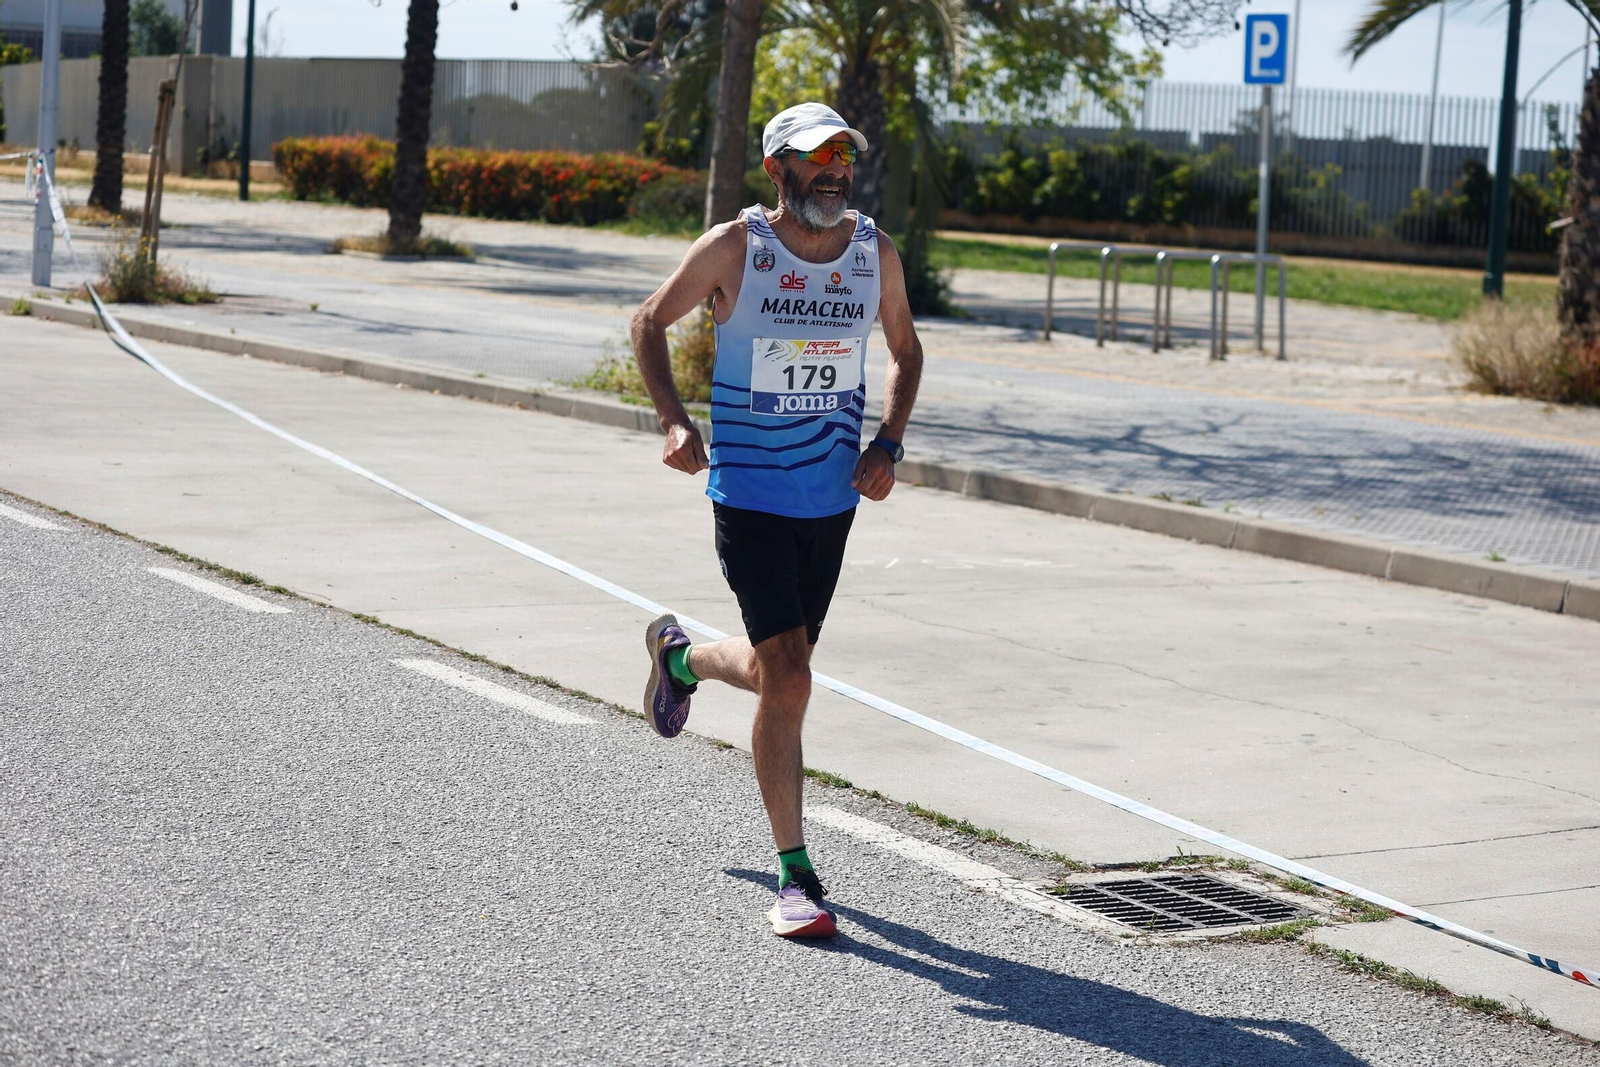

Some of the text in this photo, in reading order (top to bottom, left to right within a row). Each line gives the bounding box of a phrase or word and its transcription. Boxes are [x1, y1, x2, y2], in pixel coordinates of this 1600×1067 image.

[1251, 21, 1279, 77] P
[825, 287, 852, 296] mayfo
[761, 298, 863, 319] MARACENA
[773, 317, 796, 325] CLUB
[809, 320, 853, 329] ATLETISMO
[782, 364, 837, 390] 179
